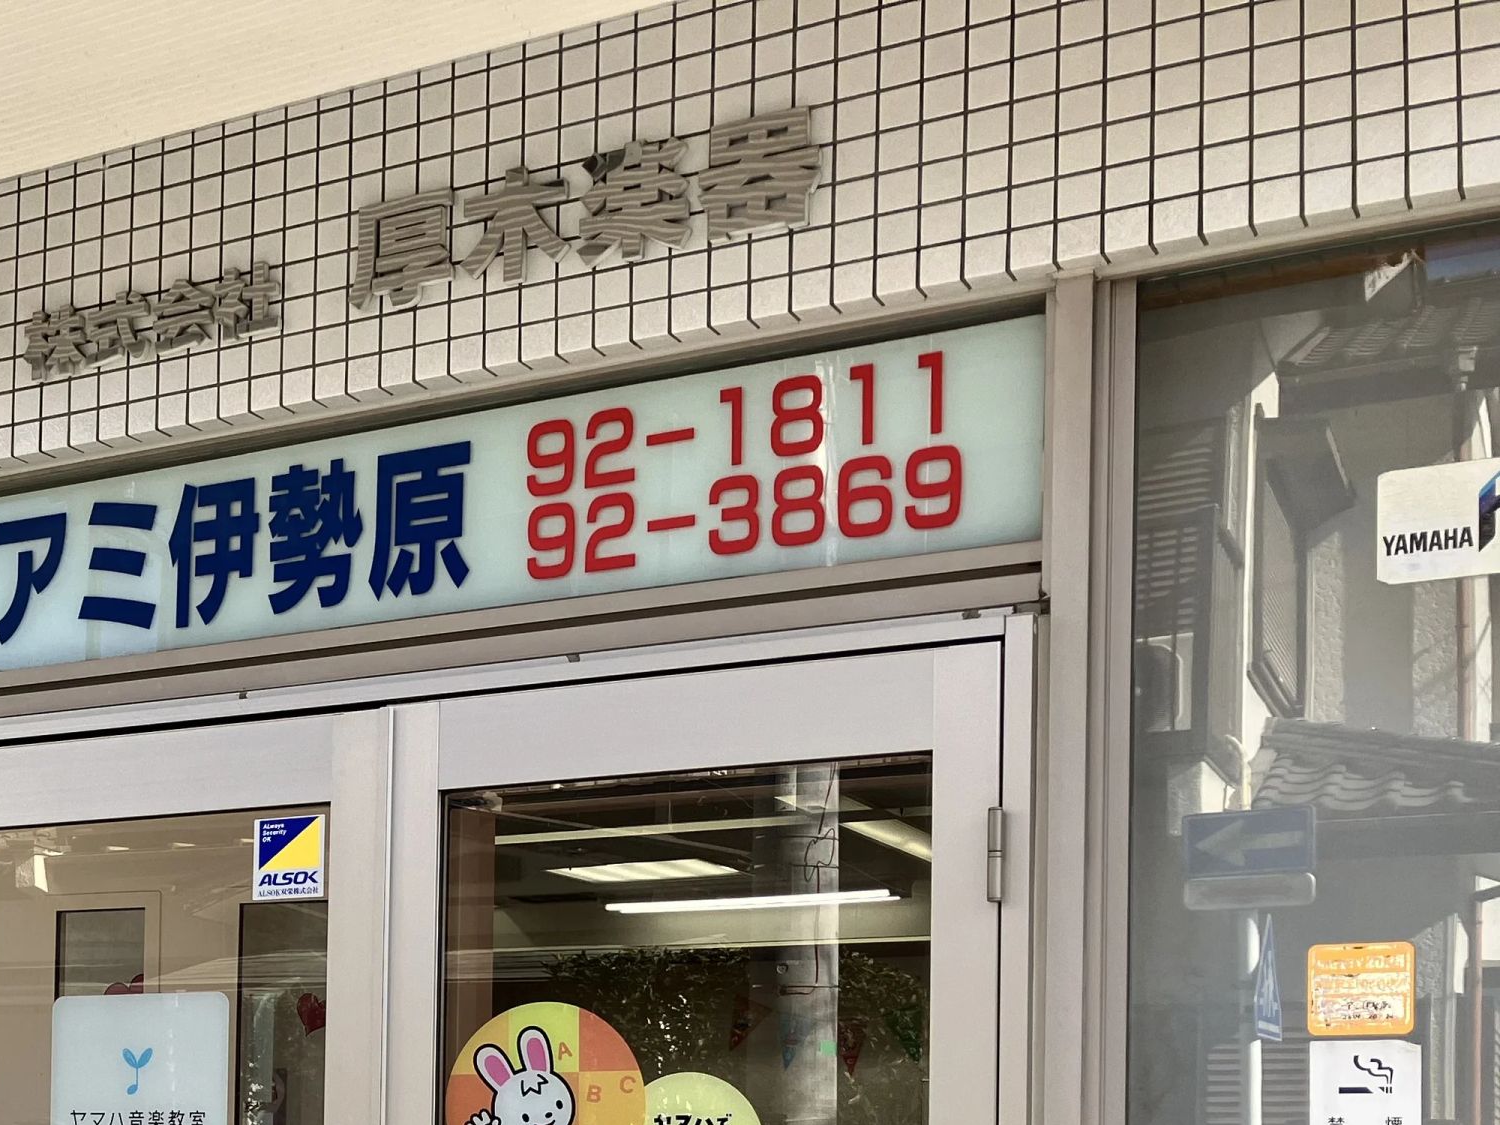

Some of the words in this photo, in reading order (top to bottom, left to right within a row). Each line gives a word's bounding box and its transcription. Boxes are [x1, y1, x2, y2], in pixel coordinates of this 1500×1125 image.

[23, 259, 282, 382] 株式会社
[349, 105, 823, 312] 厚木楽器
[527, 351, 946, 496] 92-1811
[527, 445, 962, 581] 92-3869
[1382, 526, 1474, 556] YAMAHA
[258, 870, 319, 887] ALSOK
[557, 1041, 573, 1060] A
[586, 1084, 602, 1103] B
[620, 1076, 636, 1094] C
